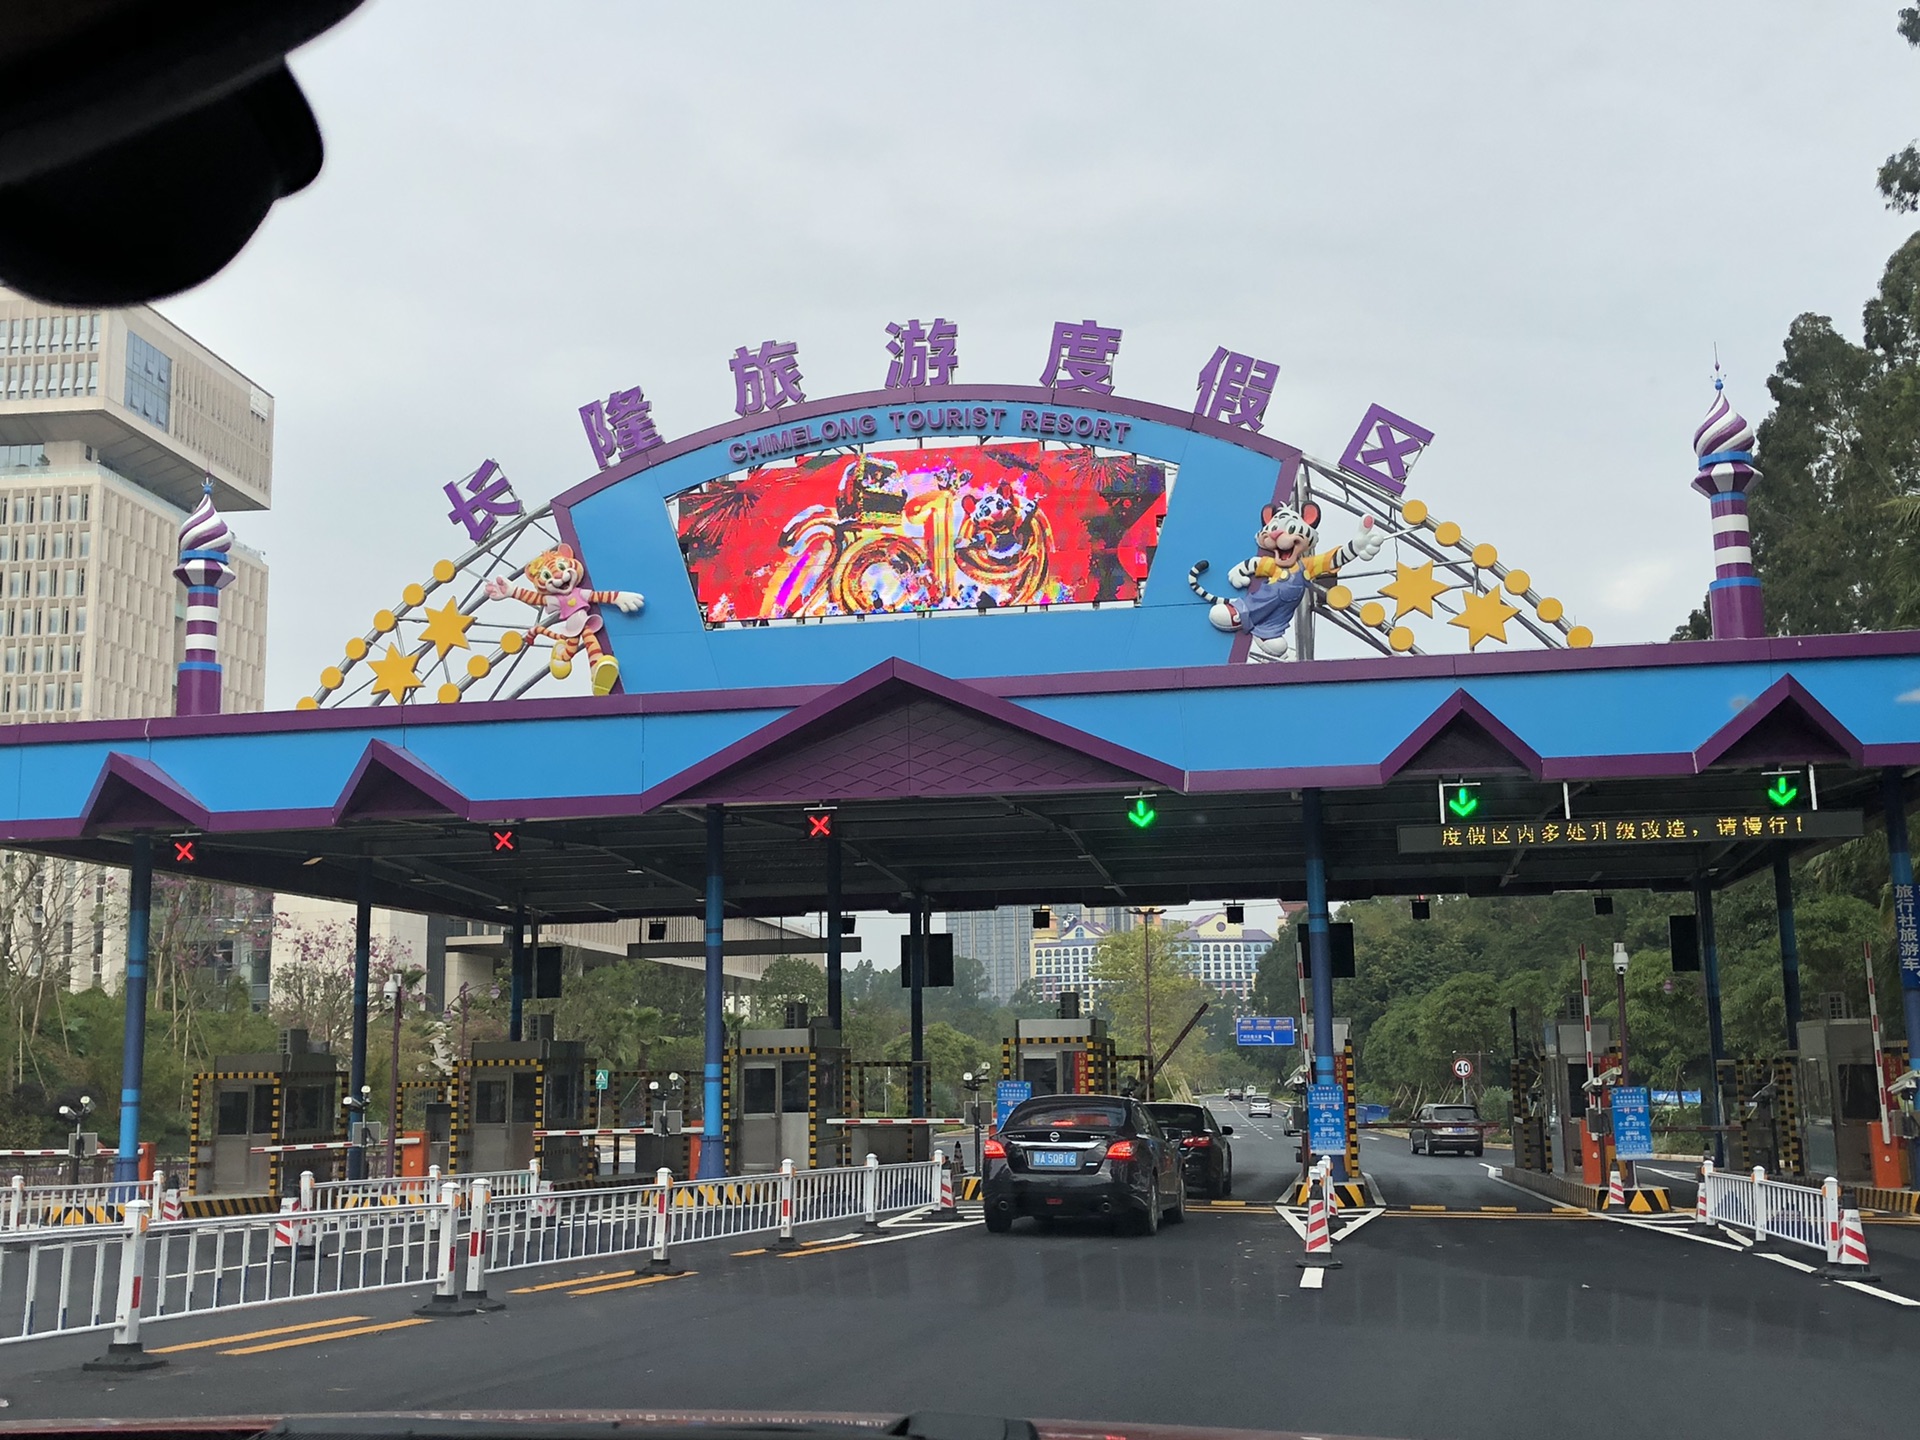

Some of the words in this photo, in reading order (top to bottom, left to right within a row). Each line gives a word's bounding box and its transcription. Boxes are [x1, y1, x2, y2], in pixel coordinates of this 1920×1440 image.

[444, 318, 1435, 543] 长隆旅游度假区
[728, 414, 877, 463] CHIMELONG
[889, 407, 1007, 432] TOURIST
[1021, 409, 1131, 443] RESORT
[1895, 884, 1920, 971] 旅行社旅游车
[1456, 1063, 1469, 1073] 40
